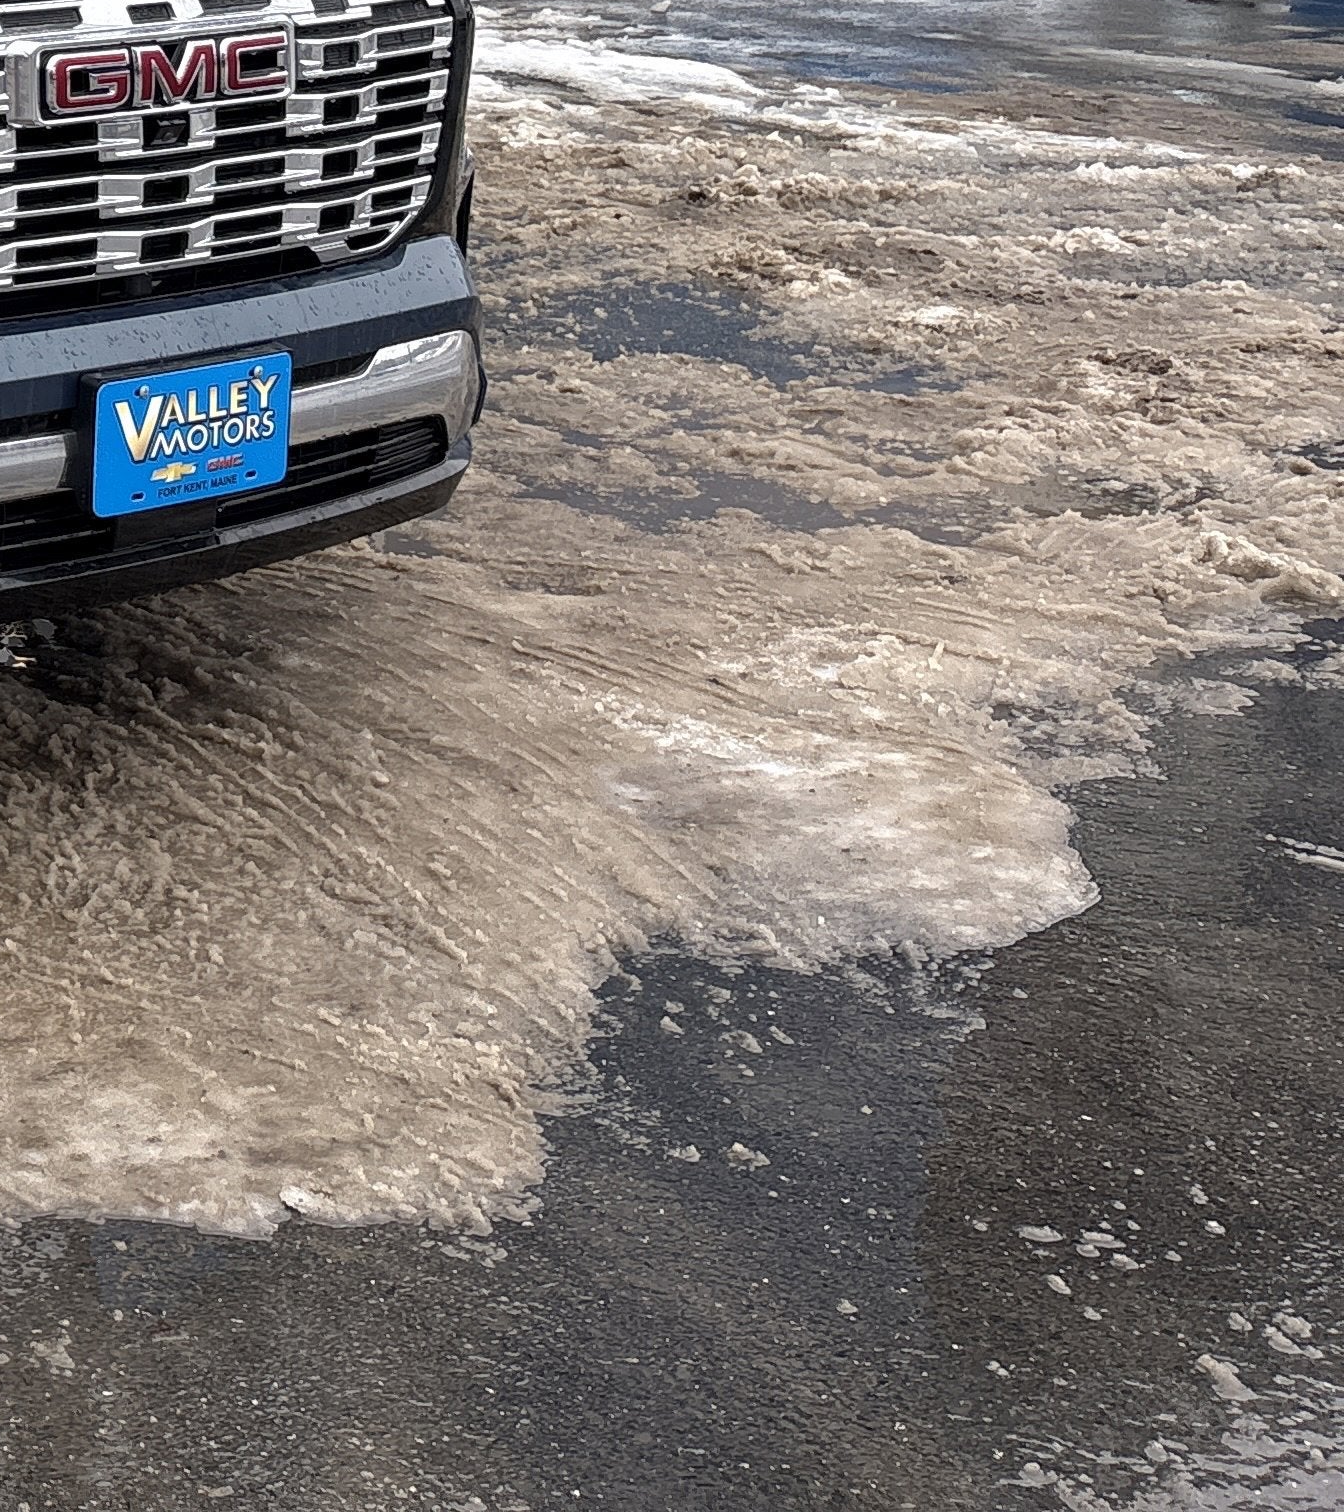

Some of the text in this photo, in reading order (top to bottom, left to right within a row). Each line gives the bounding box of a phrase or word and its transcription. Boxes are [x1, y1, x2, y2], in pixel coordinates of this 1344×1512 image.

[45, 30, 289, 116] GMC
[113, 373, 281, 463] VALLEY
[148, 410, 276, 460] MOTORS
[157, 484, 183, 498] FORT
[211, 473, 238, 488] MAINE
